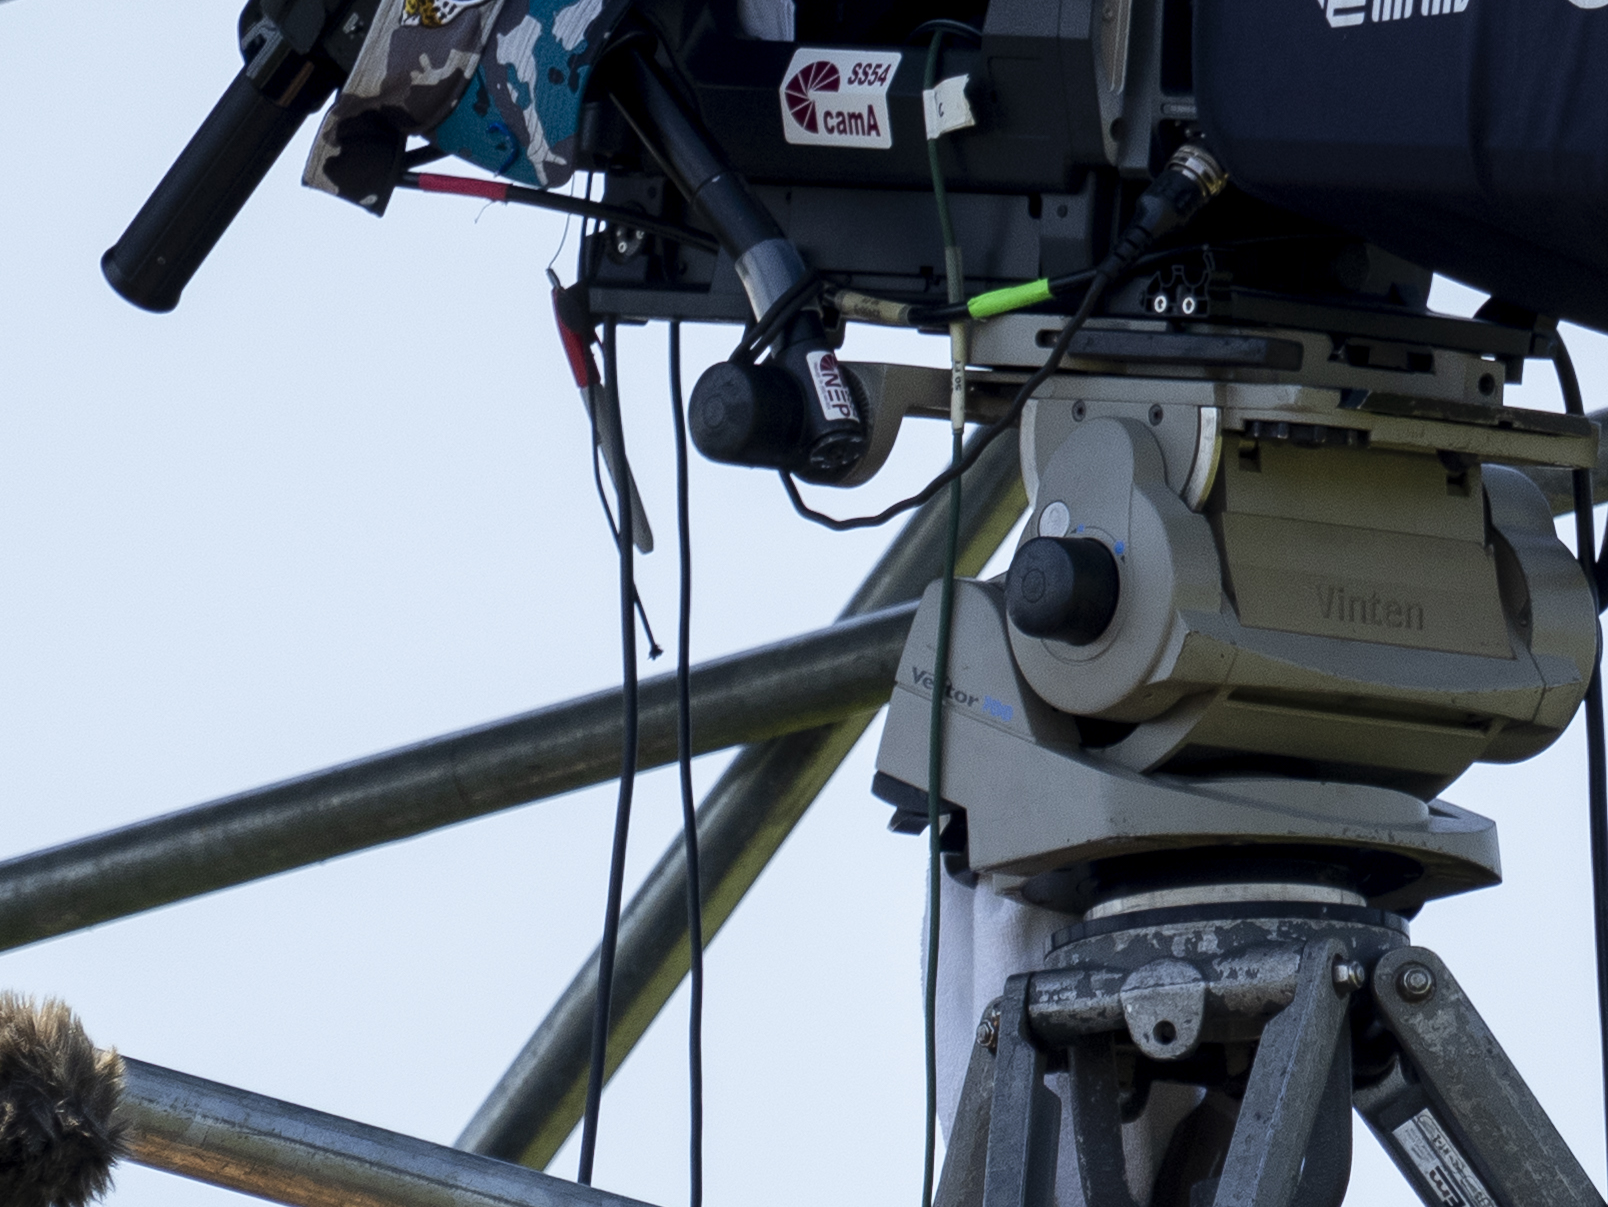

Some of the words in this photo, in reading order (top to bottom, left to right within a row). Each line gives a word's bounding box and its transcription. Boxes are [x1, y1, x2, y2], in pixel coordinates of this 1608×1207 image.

[847, 62, 892, 87] SS54
[823, 105, 882, 137] camA
[822, 371, 850, 417] NEP
[1316, 584, 1425, 631] Vinten
[912, 666, 979, 707] Vetor
